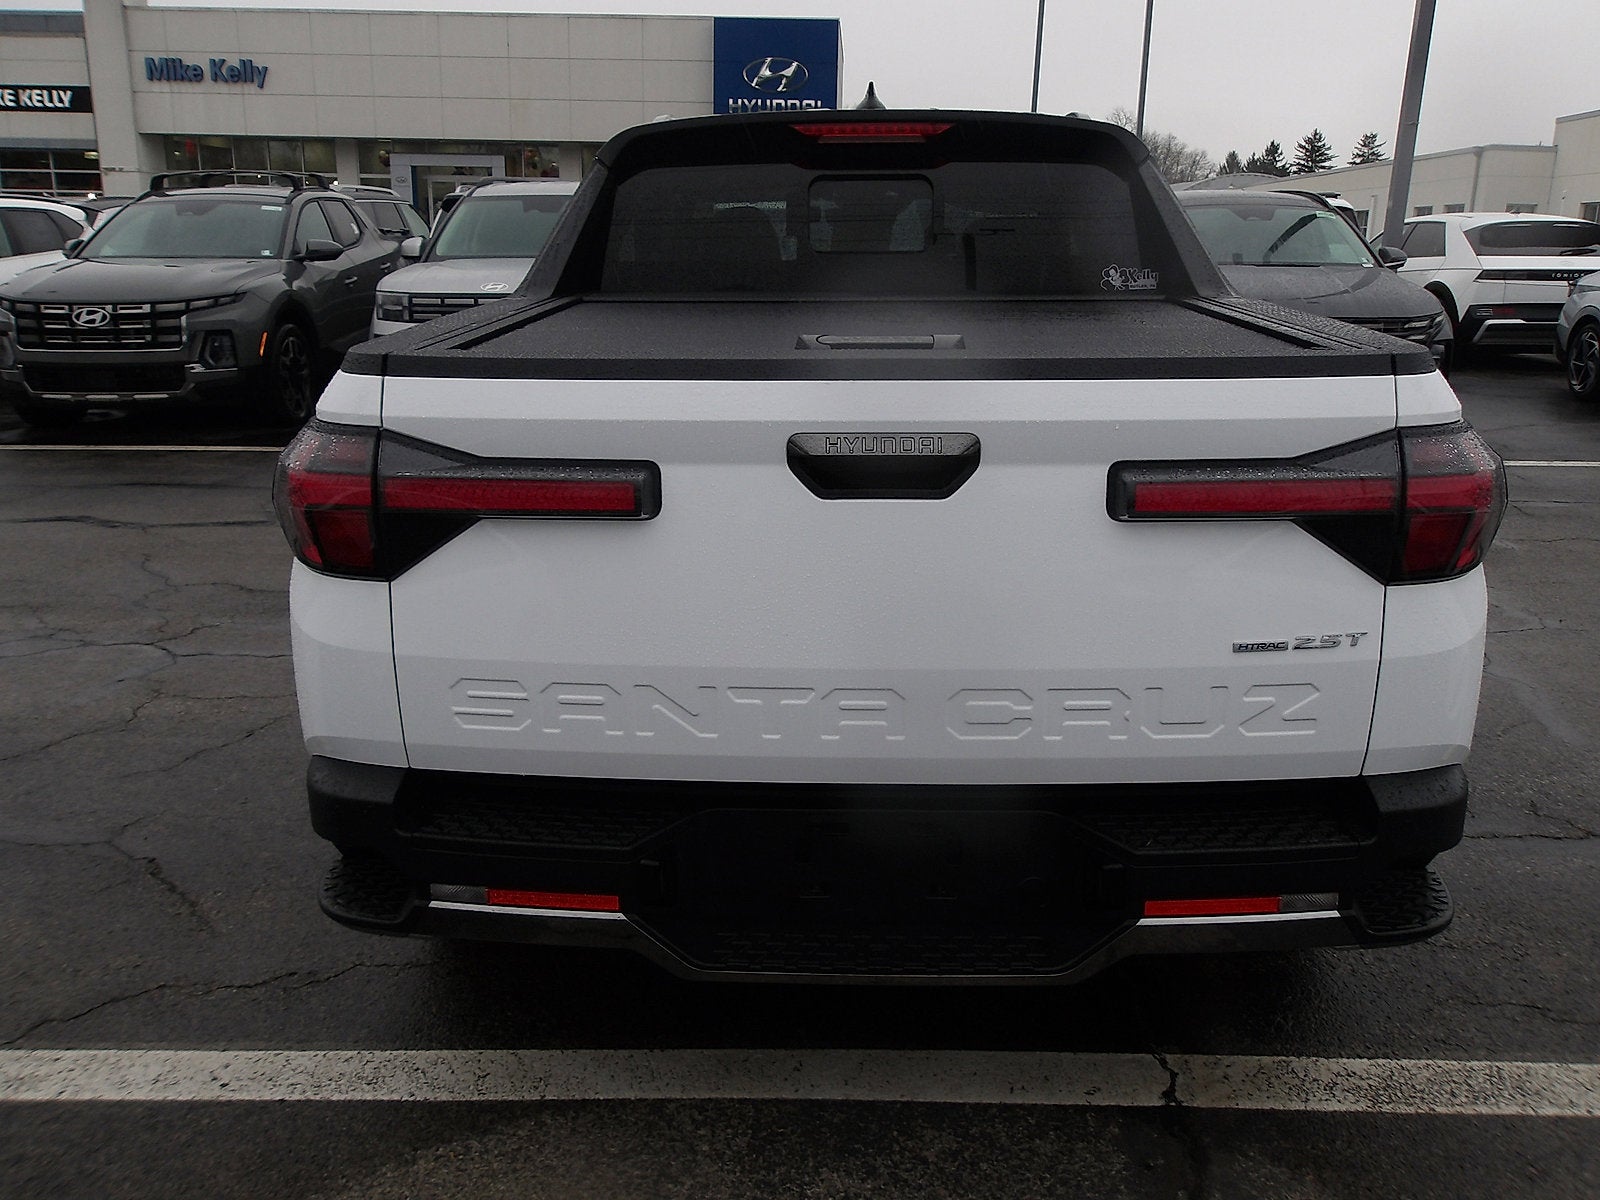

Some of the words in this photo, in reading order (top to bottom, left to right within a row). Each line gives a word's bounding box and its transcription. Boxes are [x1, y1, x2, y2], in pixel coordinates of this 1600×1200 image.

[144, 57, 204, 82] Mike
[208, 58, 268, 89] Kelly
[17, 88, 73, 108] KELLY
[1127, 267, 1159, 284] Kelly
[825, 436, 943, 454] HYUNDAI
[1237, 641, 1286, 651] HTRAC
[449, 677, 907, 740] SANTA
[946, 682, 1321, 740] CRUZ
